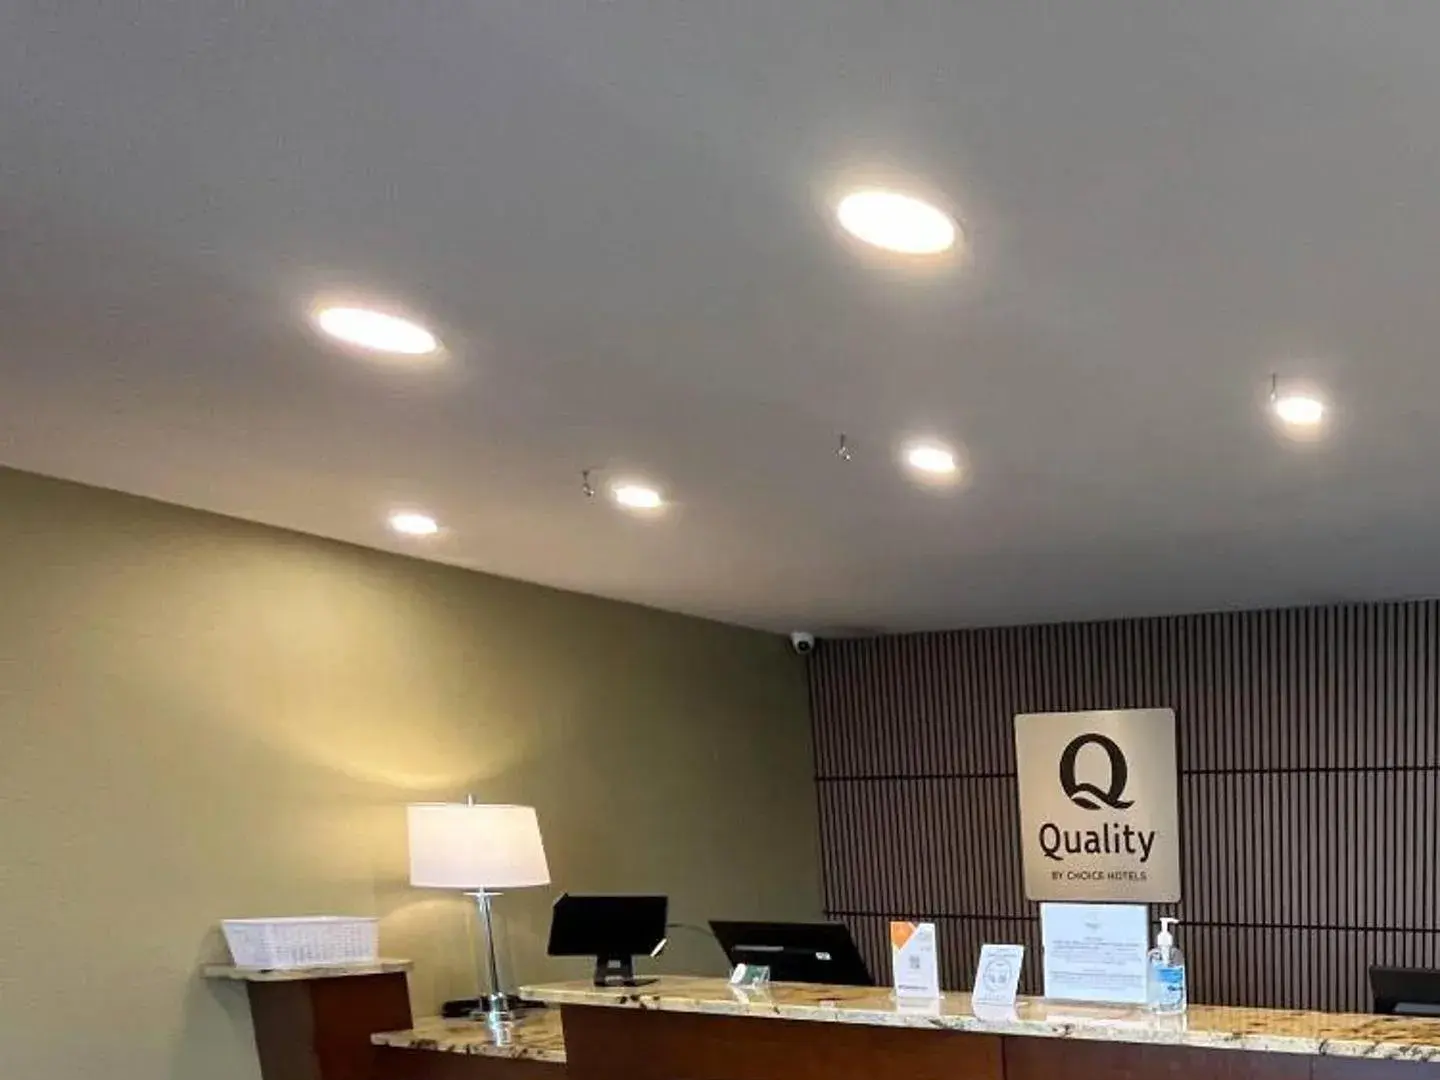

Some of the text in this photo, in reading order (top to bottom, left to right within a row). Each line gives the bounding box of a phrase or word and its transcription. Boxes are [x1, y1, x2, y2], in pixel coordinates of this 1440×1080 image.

[1060, 733, 1135, 810] Q
[1039, 823, 1155, 863] Quality
[1052, 871, 1147, 881] BY CHOICE HOTELS
